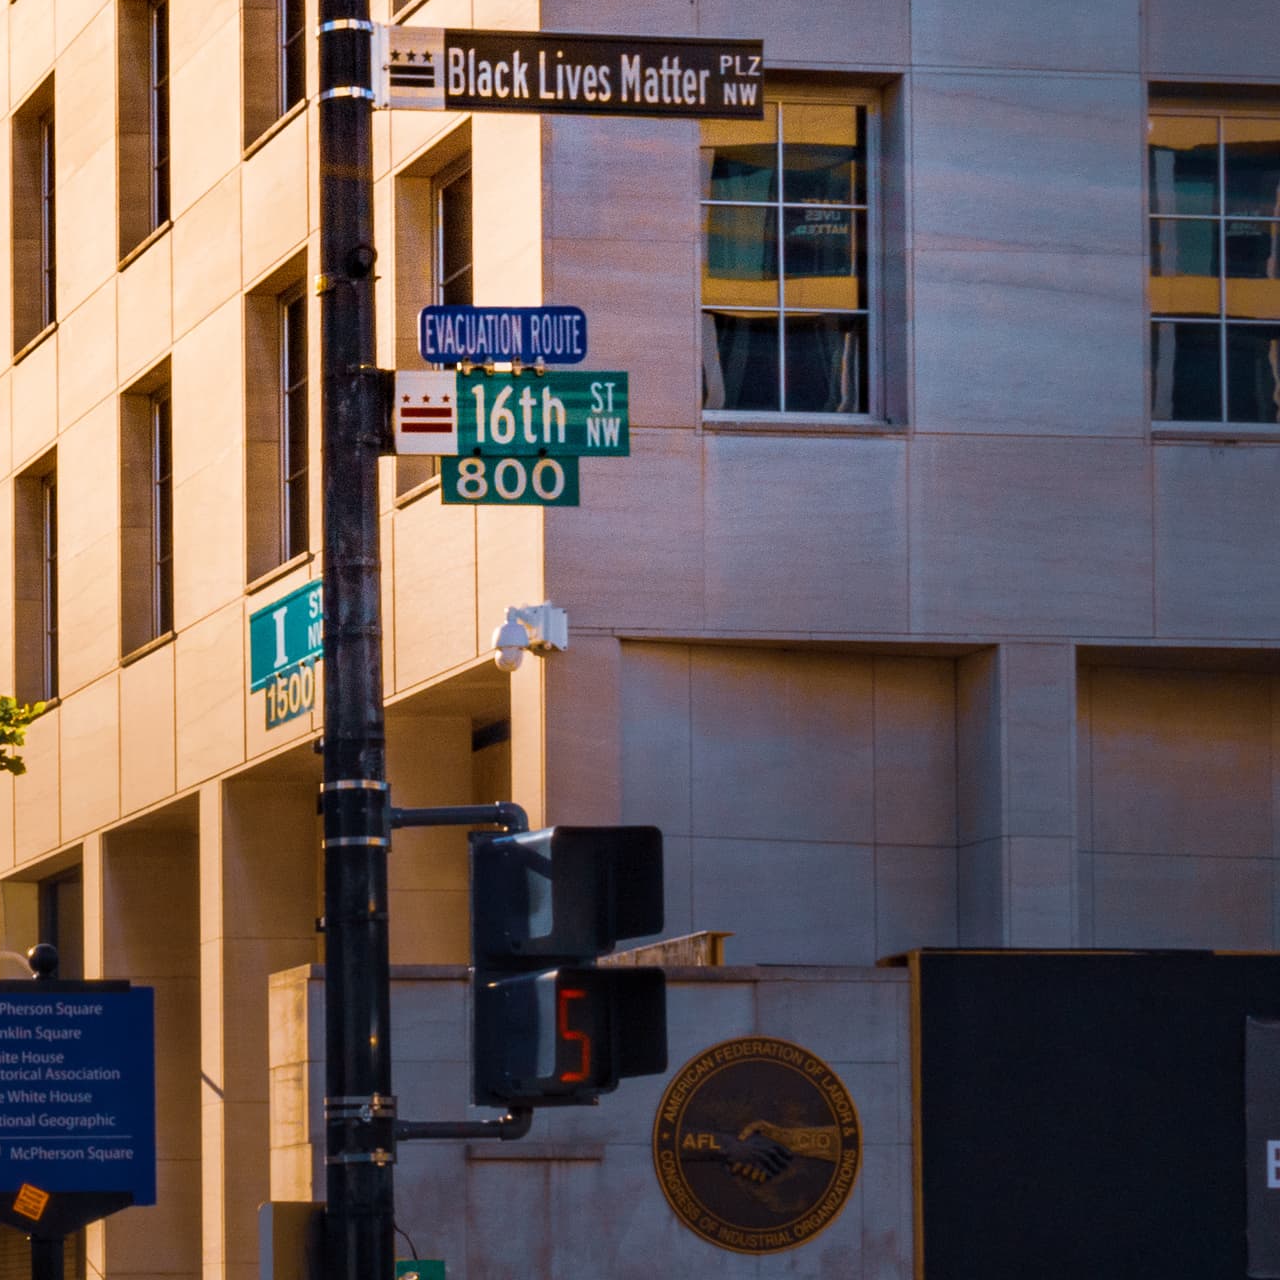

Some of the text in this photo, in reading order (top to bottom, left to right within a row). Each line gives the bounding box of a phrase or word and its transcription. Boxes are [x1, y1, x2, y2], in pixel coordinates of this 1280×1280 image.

[448, 47, 710, 105] Black Lives Matter
[720, 55, 761, 76] PLZ
[723, 82, 758, 106] NW
[425, 313, 582, 355] EVACUATION ROUTE
[590, 382, 616, 413] ST
[471, 383, 567, 445] 16th
[586, 417, 621, 447] NW
[456, 457, 566, 500] 800
[272, 606, 288, 669] I
[267, 666, 314, 722] 1500
[56, 1002, 103, 1017] Square
[35, 1026, 82, 1042] Square
[560, 989, 590, 1082] 5
[22, 1051, 64, 1064] House
[45, 1067, 120, 1080] Association
[664, 1056, 715, 1123] AMERICAN
[716, 1042, 803, 1064] FEDERATION
[804, 1059, 824, 1075] OF
[822, 1073, 853, 1124] LABOR
[8, 1091, 46, 1103] White
[50, 1090, 92, 1103] House
[39, 1114, 116, 1130] Geographic
[10, 1146, 84, 1159] McPherson
[88, 1146, 134, 1162] Square
[682, 1134, 831, 1150] AFL CIO
[660, 1150, 856, 1248] CONGRESS OF INDUSTRIAL ORGANIZATIONS
